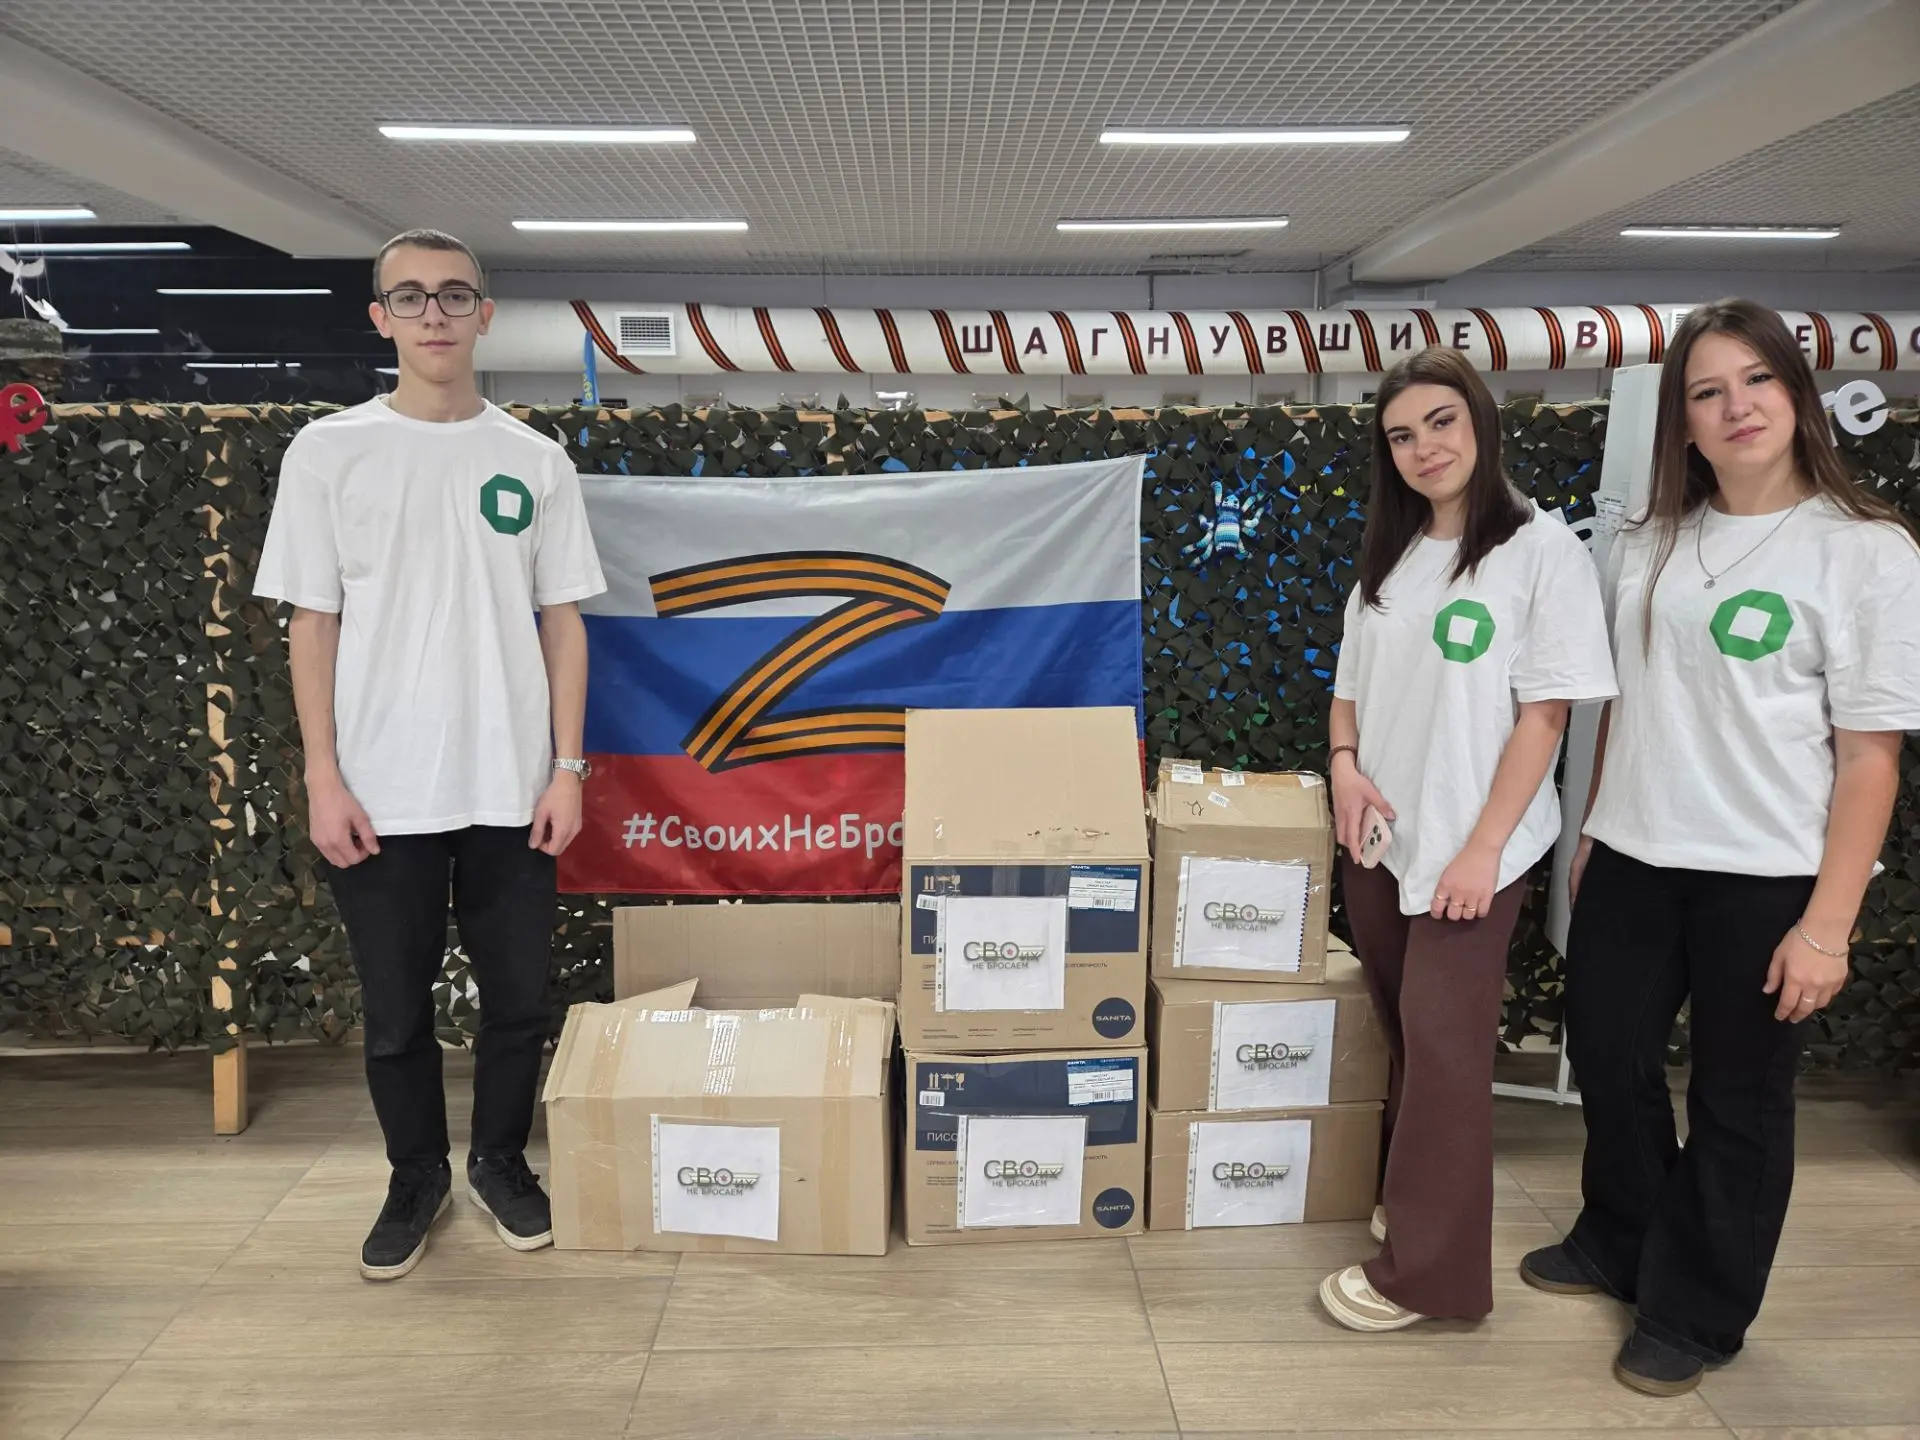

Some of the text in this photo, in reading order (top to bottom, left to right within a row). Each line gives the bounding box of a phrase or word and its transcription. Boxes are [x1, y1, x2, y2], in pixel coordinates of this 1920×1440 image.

[961, 323, 1472, 357] ШАГНУВШИЕ
[1576, 320, 1598, 348] В
[972, 962, 1029, 970] НЕ БРОСАЕМ
[1243, 1061, 1298, 1071] НЕ БРОСАЕМ
[1006, 1179, 1047, 1187] БРОСАЕМ
[1234, 1180, 1274, 1189] БРОСАЕМ
[686, 1187, 743, 1197] НЕ БРОСАЕМ
[1095, 1204, 1131, 1212] SANITA
